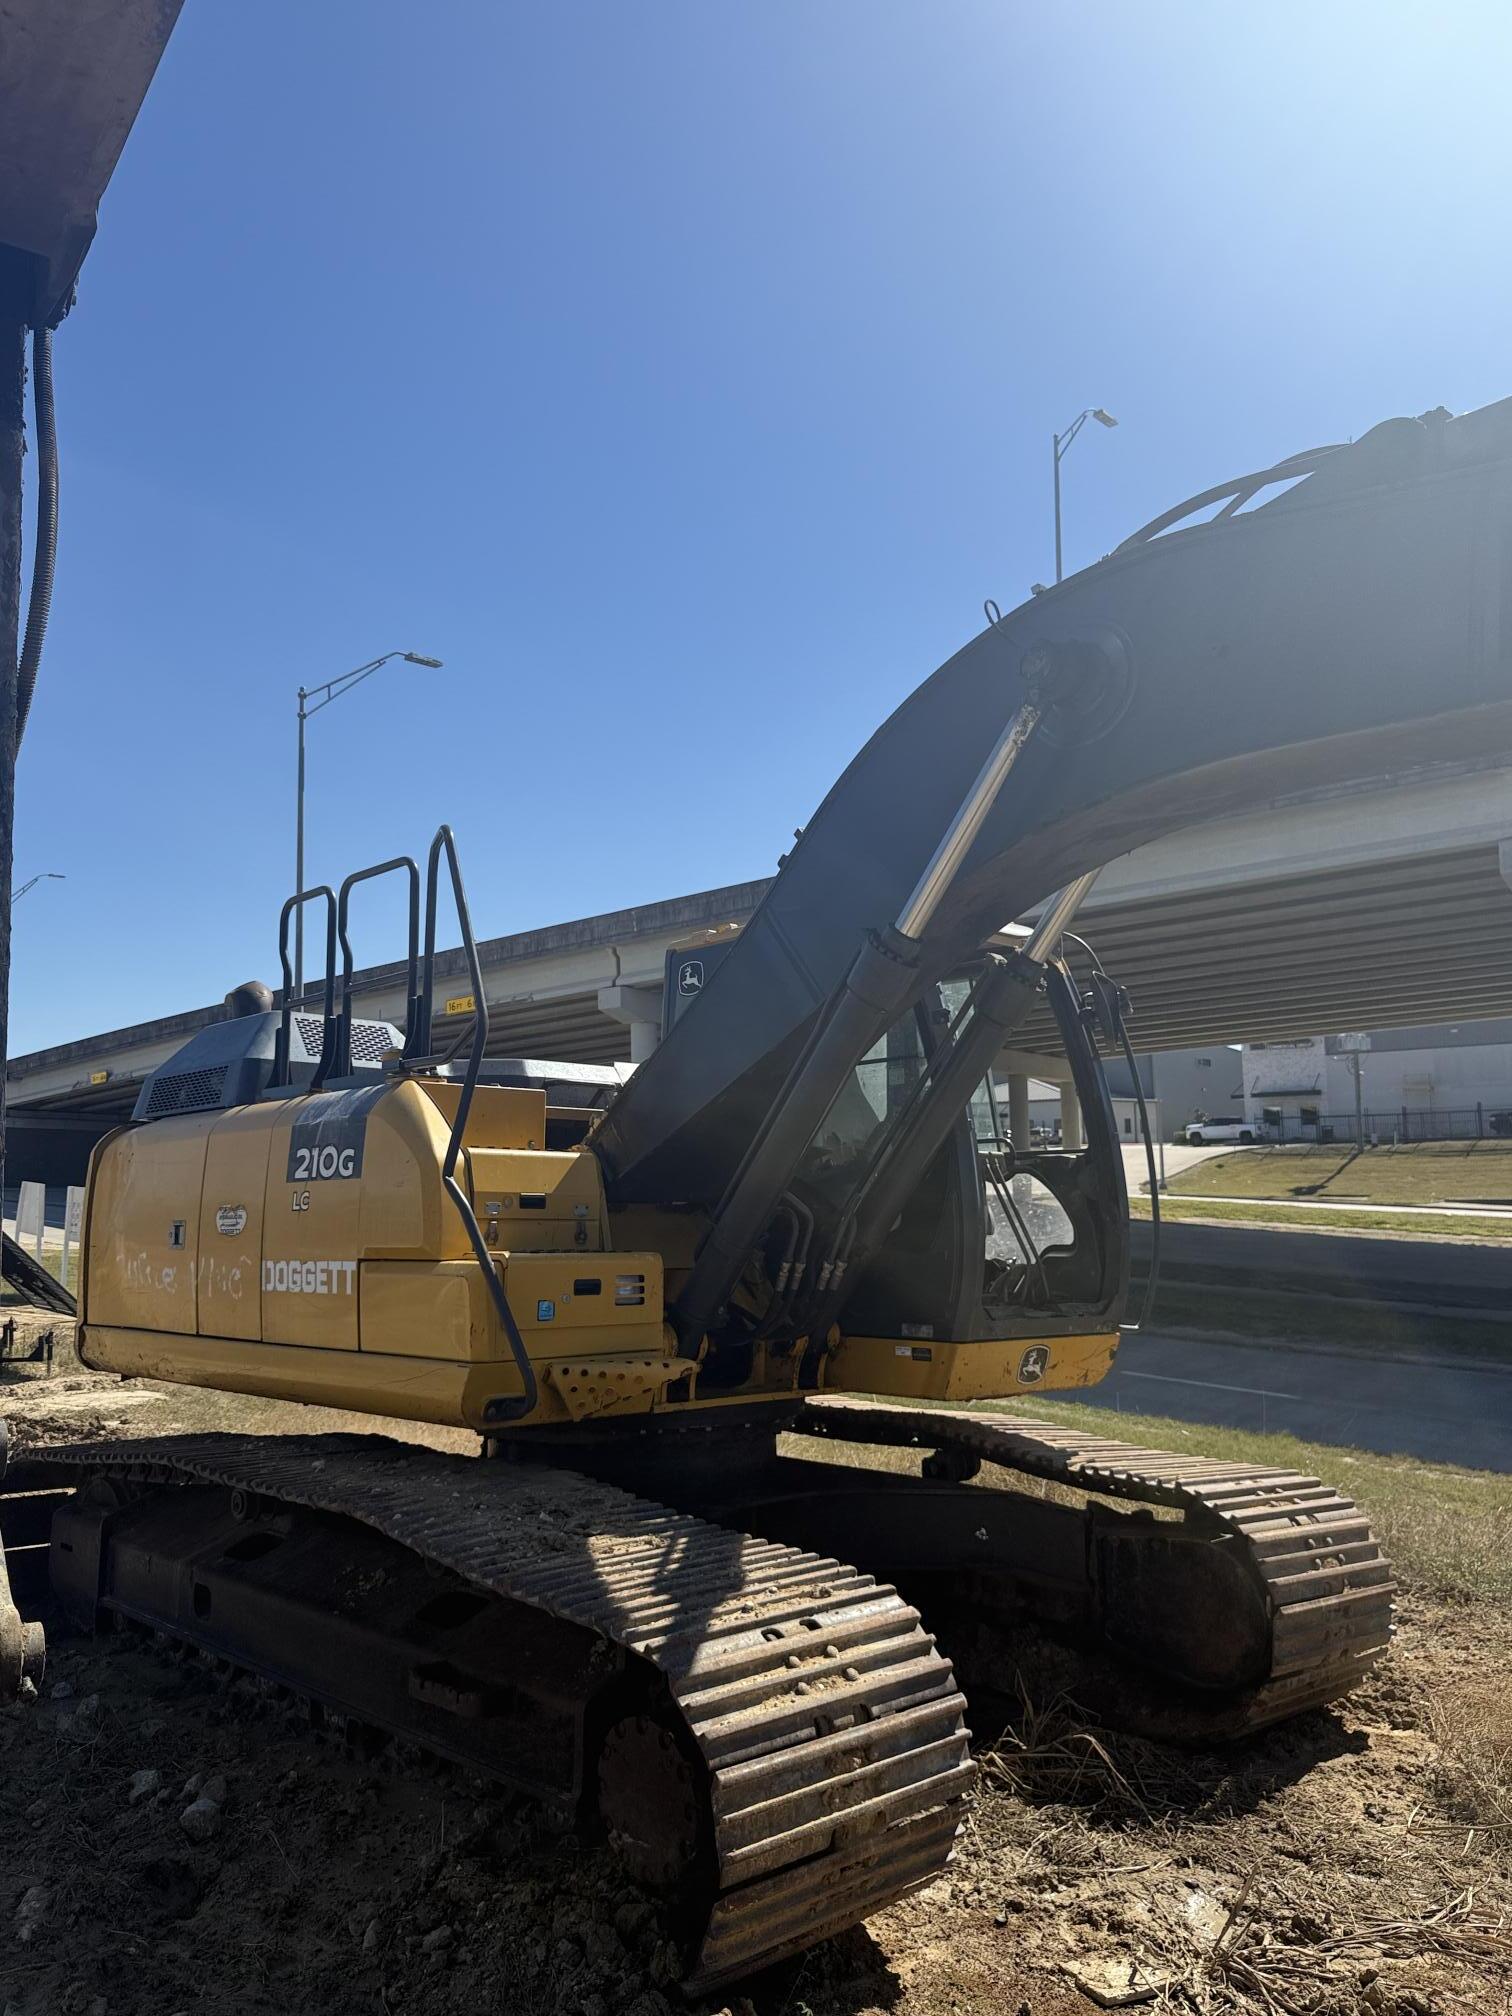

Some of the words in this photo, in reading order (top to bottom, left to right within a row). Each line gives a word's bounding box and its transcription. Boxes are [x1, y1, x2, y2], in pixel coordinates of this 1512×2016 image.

[294, 1145, 355, 1179] 210G
[292, 1191, 310, 1211] LC
[262, 1259, 357, 1295] DOGGETT
